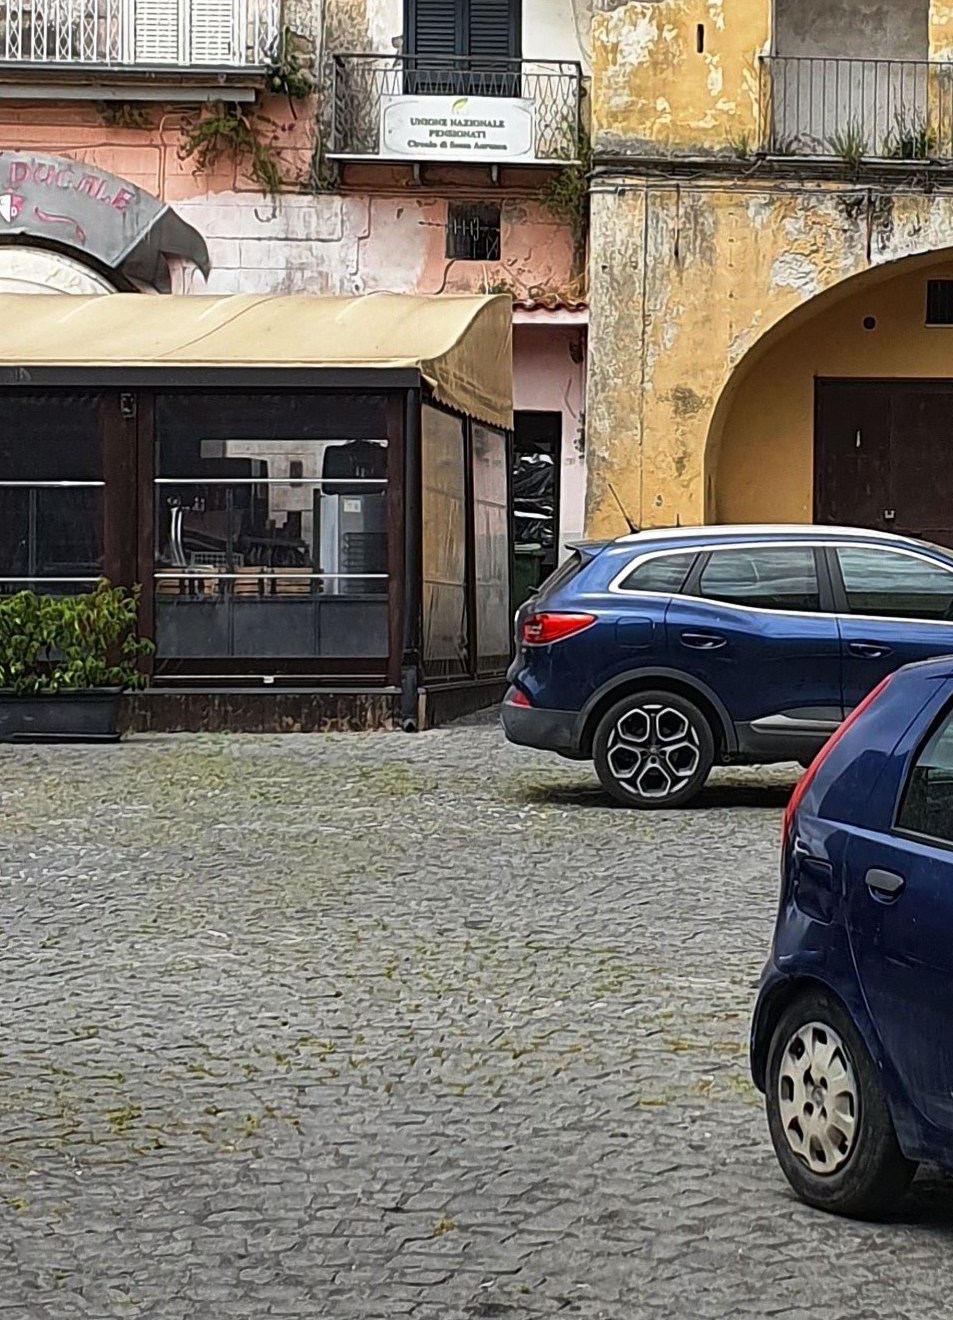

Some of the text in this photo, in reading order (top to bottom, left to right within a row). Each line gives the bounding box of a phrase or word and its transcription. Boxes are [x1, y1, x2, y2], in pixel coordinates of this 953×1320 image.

[410, 117, 505, 128] UNIONE NAZIONALE
[428, 130, 486, 139] PENSIONATI
[9, 161, 135, 213] DUCALE
